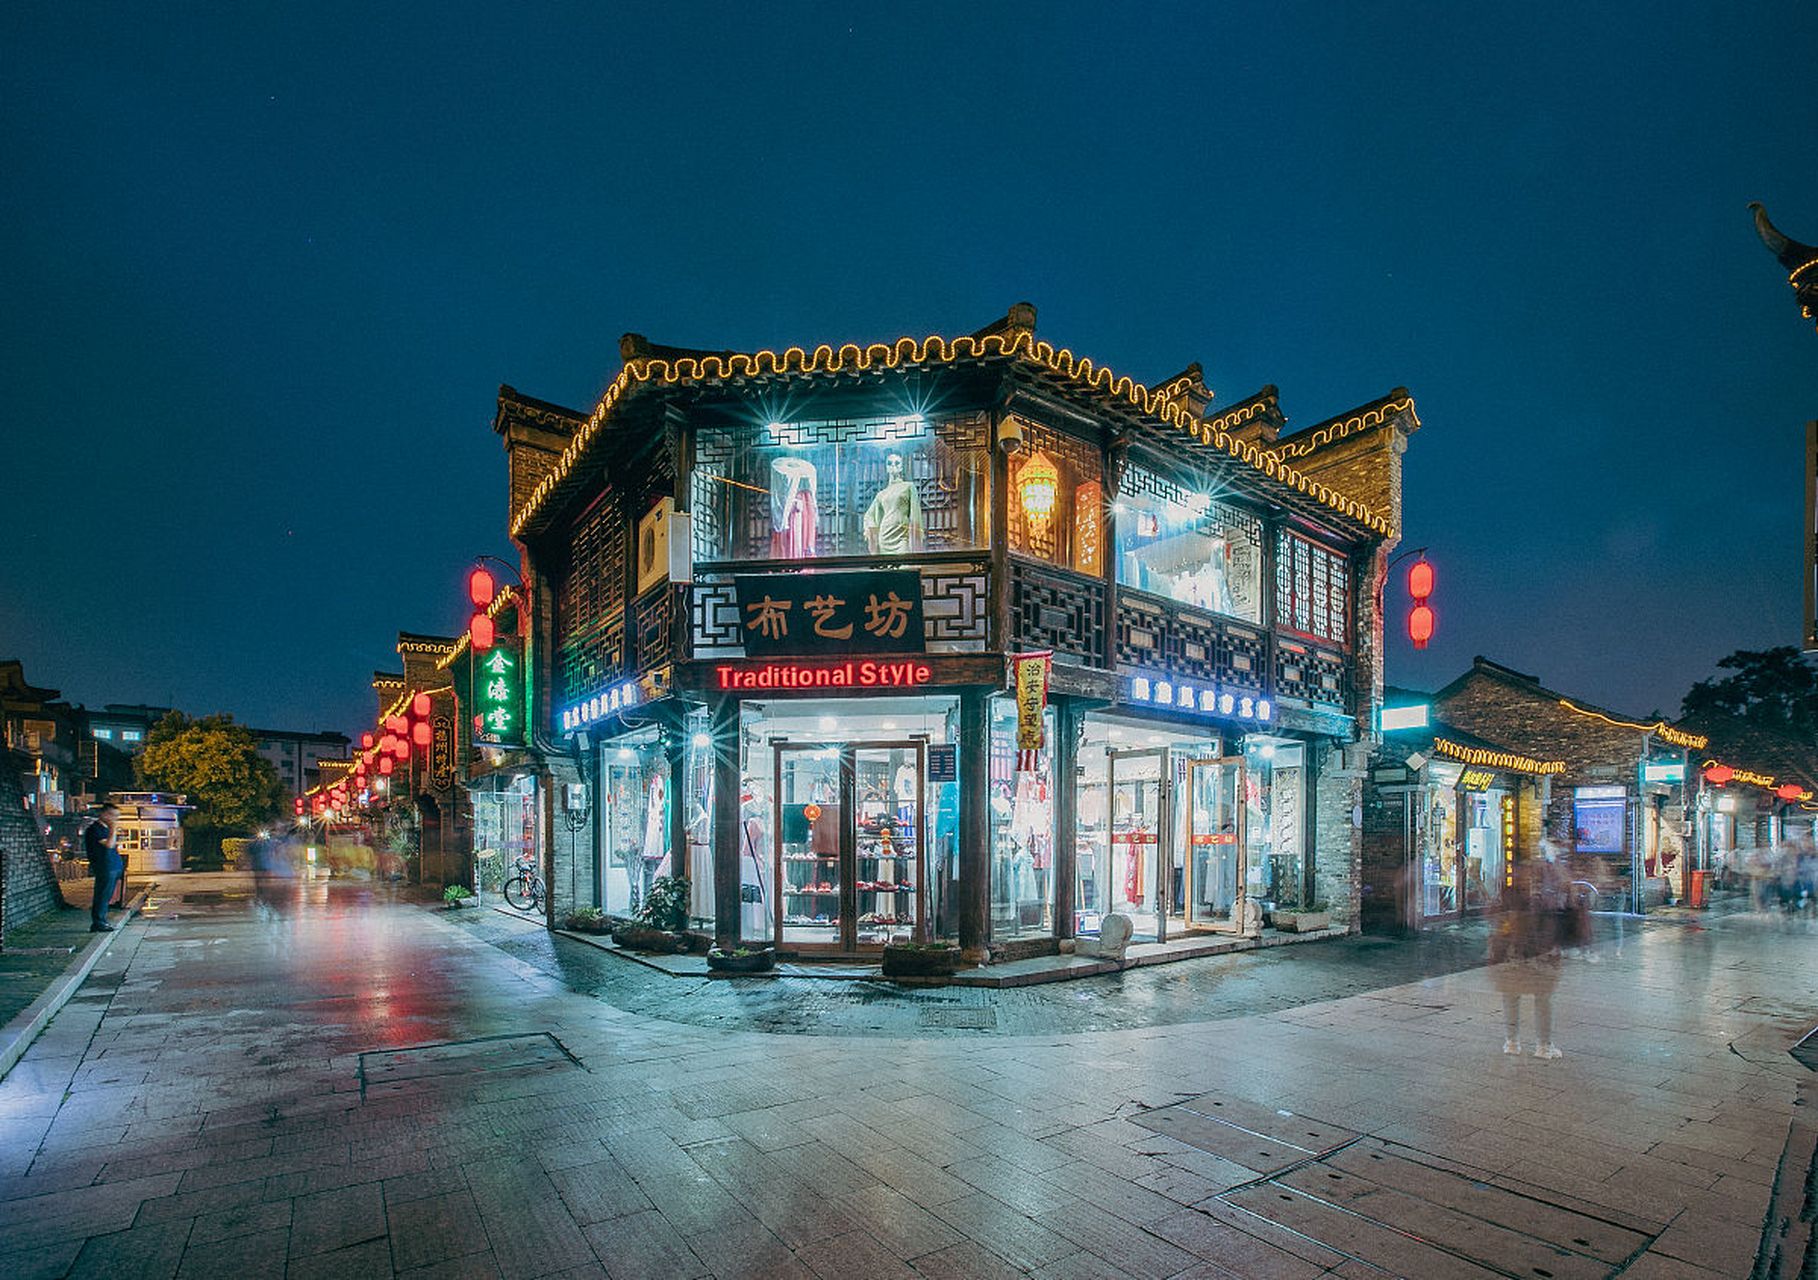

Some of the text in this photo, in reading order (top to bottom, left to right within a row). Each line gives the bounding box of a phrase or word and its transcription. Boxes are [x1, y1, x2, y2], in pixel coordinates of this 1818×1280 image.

[746, 592, 913, 640] 布艺坊
[717, 662, 931, 688] Traditional Style
